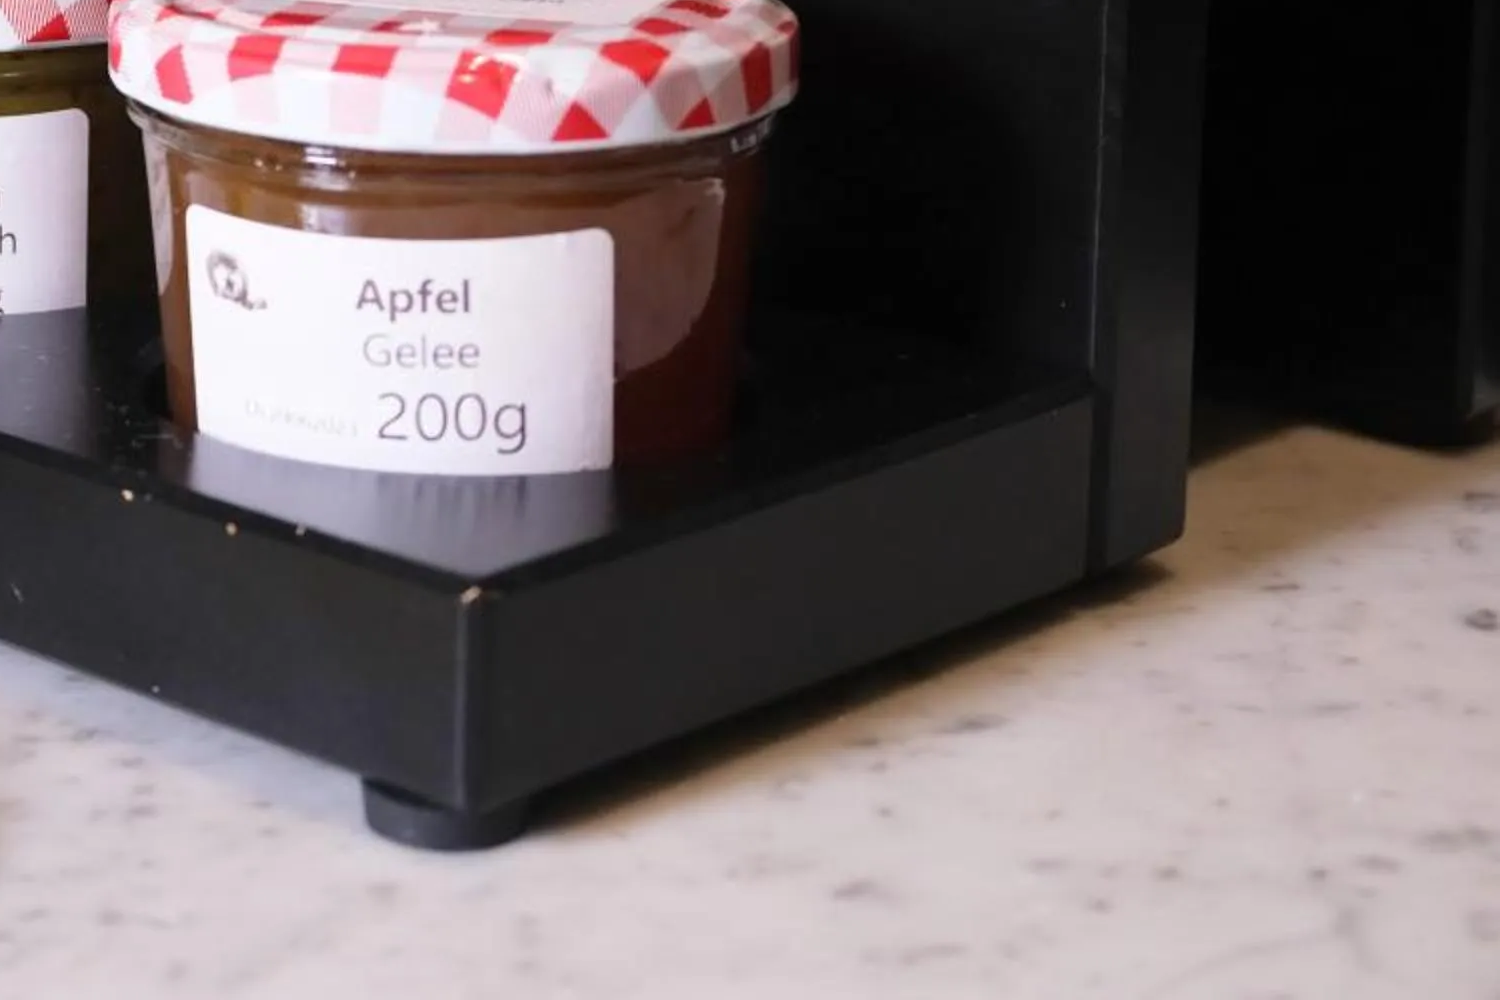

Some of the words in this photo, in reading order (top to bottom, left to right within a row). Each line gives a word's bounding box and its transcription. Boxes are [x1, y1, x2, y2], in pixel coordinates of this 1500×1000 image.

[355, 278, 472, 323] Apfel
[362, 332, 481, 370] Gelee
[376, 392, 528, 455] 200g
